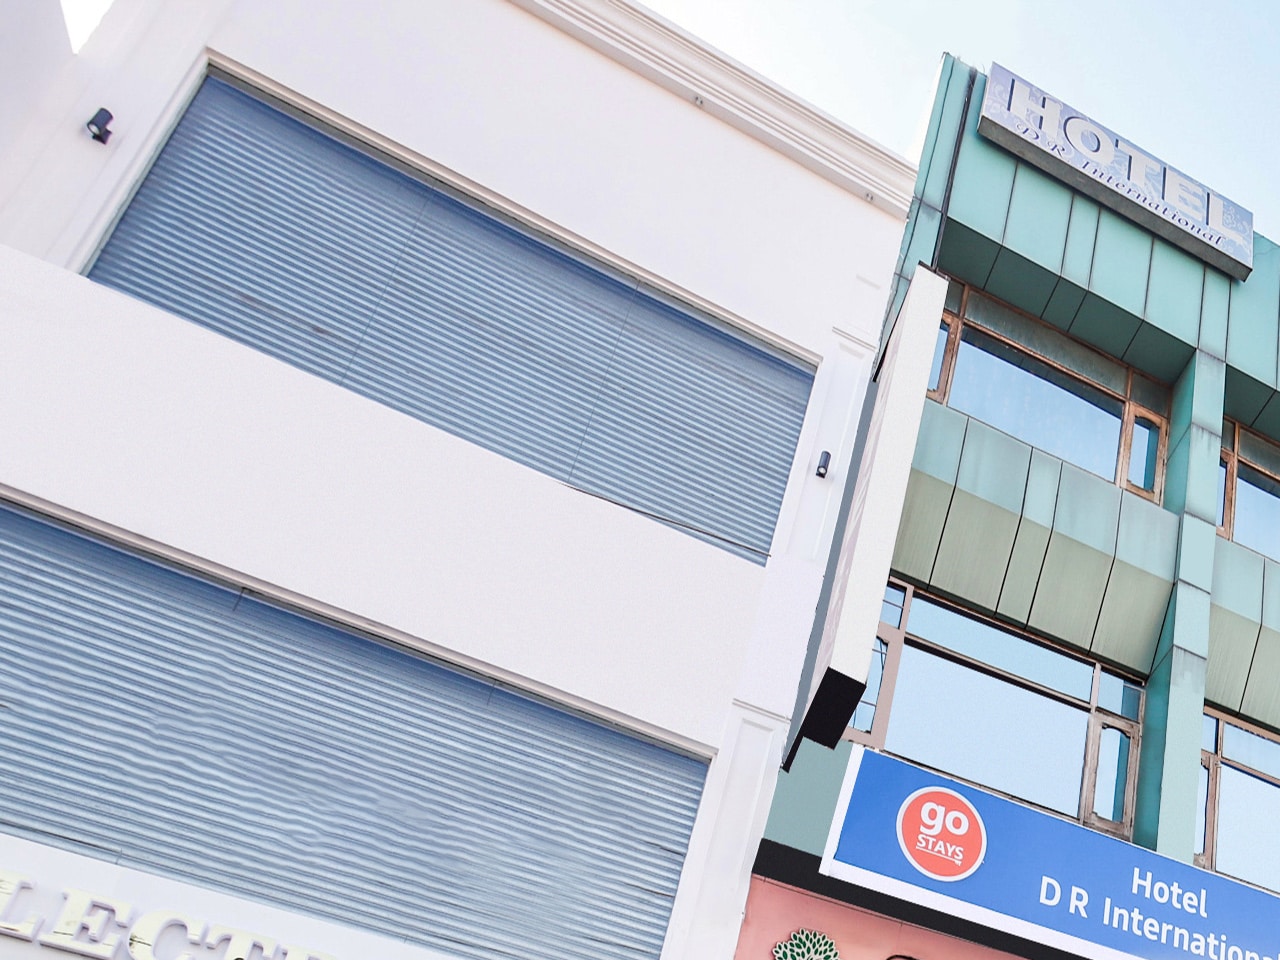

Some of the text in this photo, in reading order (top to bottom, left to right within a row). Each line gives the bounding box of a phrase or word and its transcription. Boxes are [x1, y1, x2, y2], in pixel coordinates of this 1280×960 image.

[1006, 77, 1244, 241] HOTEL
[1081, 159, 1226, 246] International
[920, 801, 969, 836] go
[916, 833, 963, 860] STAYS
[1040, 876, 1062, 905] D
[1069, 887, 1089, 919] R
[1132, 868, 1208, 919] Hotel
